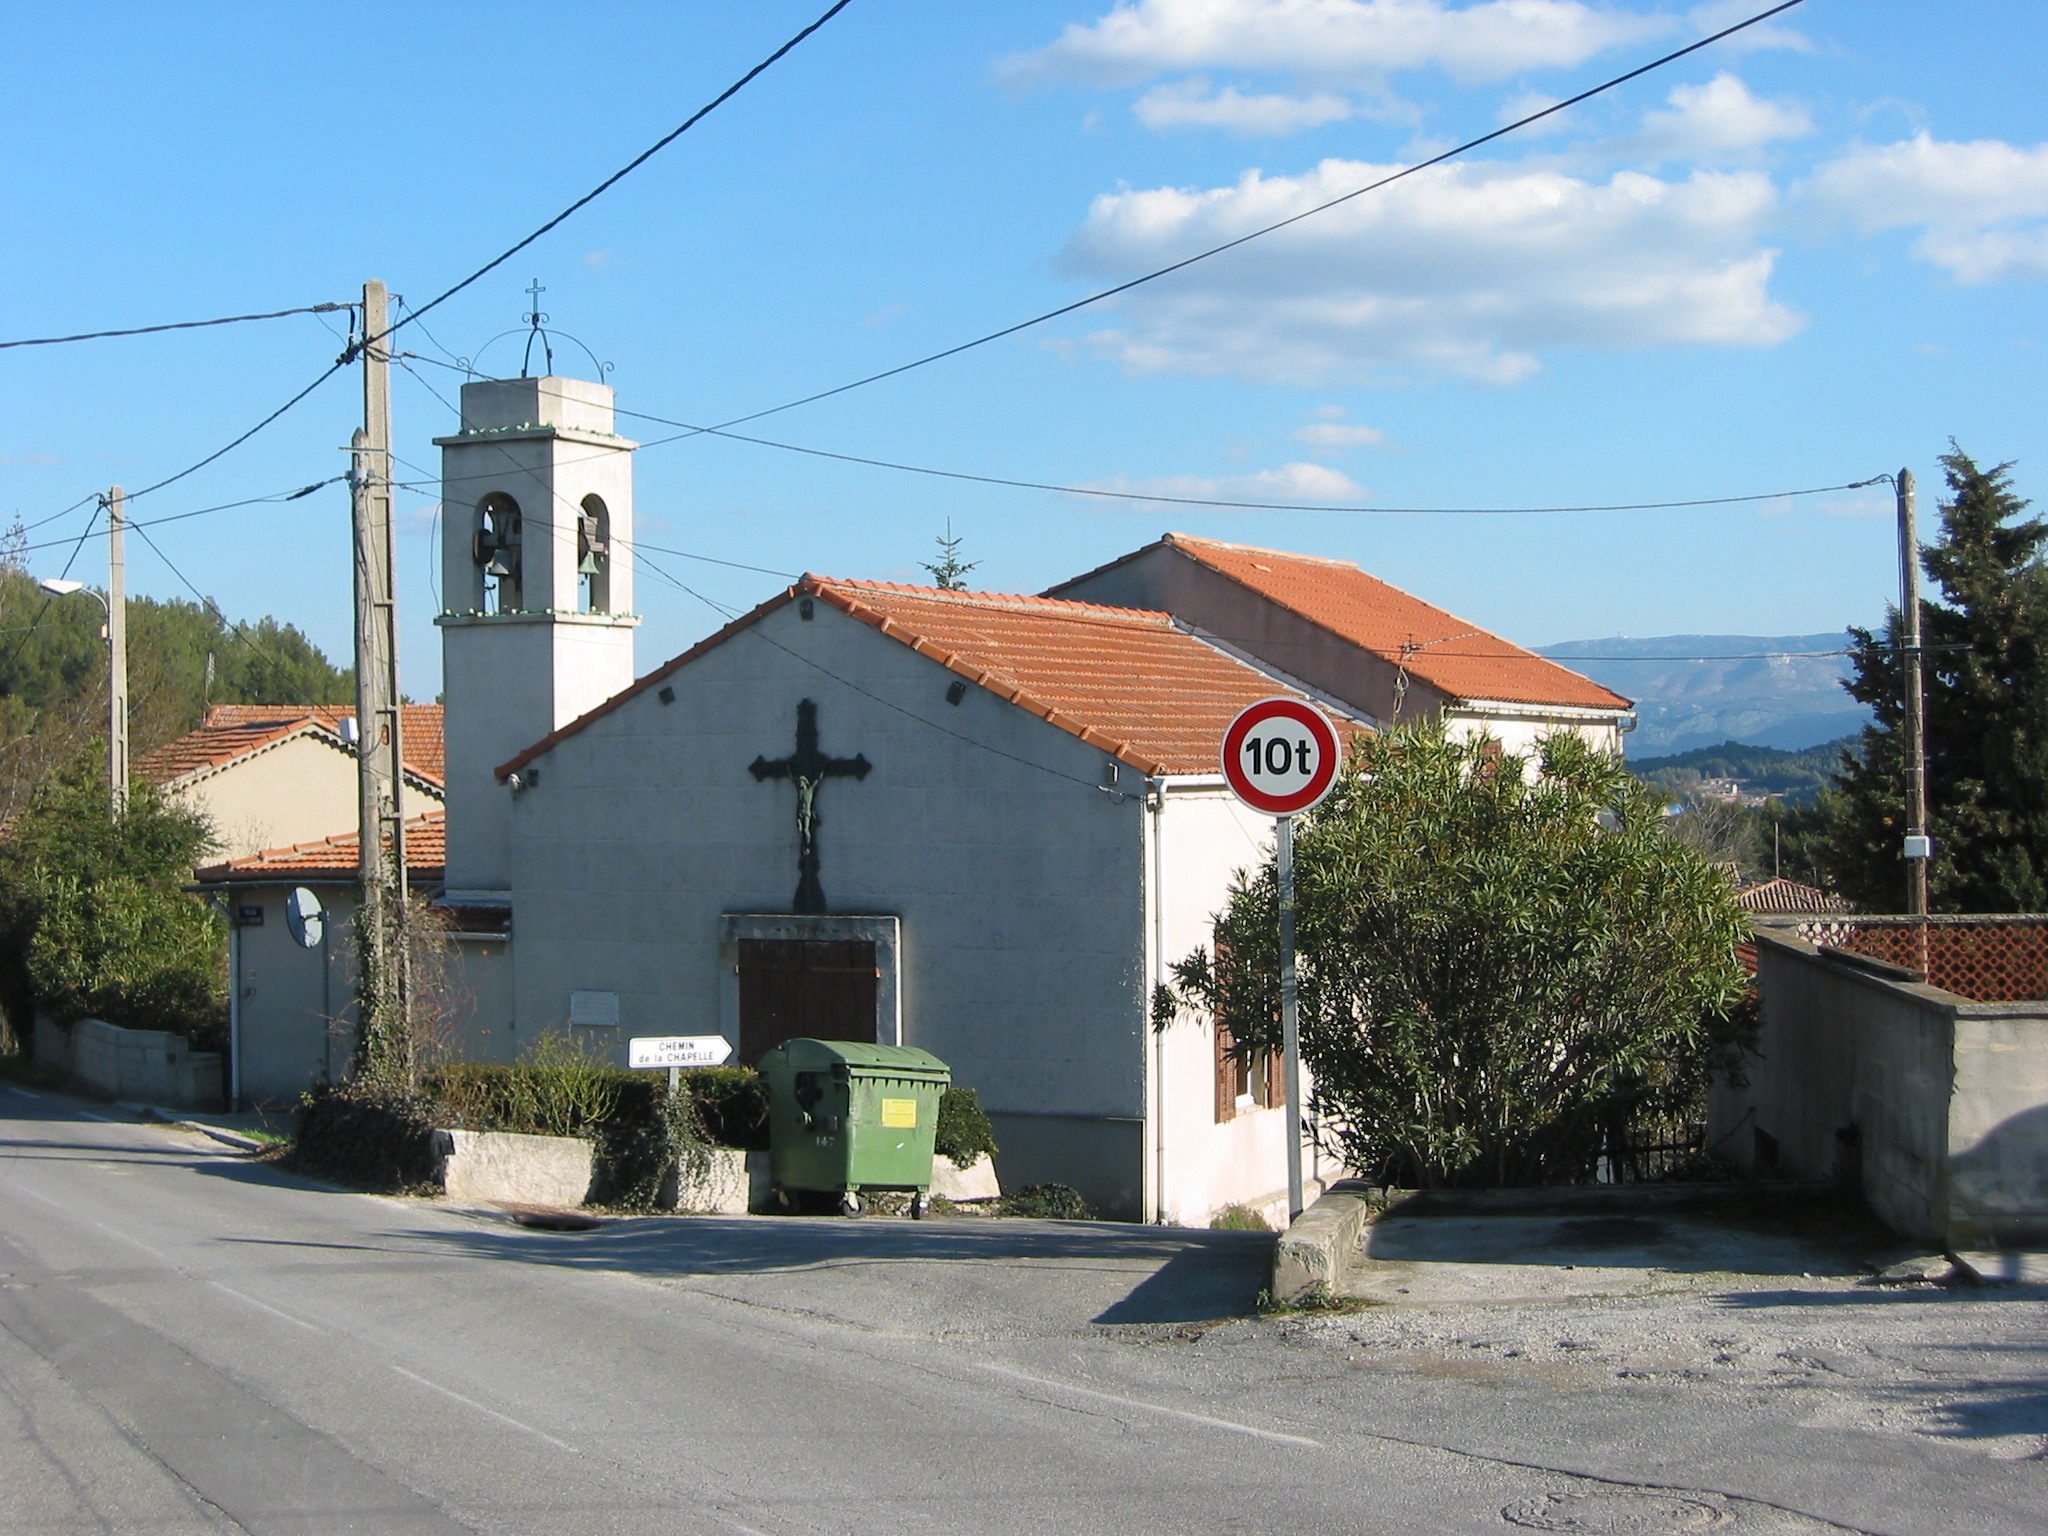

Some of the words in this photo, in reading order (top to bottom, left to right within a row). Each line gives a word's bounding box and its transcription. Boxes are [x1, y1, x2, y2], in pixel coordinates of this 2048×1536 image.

[1246, 737, 1311, 775] 10t
[659, 1042, 695, 1051] CHEMIN
[639, 1054, 650, 1063] de
[654, 1054, 663, 1062] la
[667, 1051, 714, 1062] CHAPELLE
